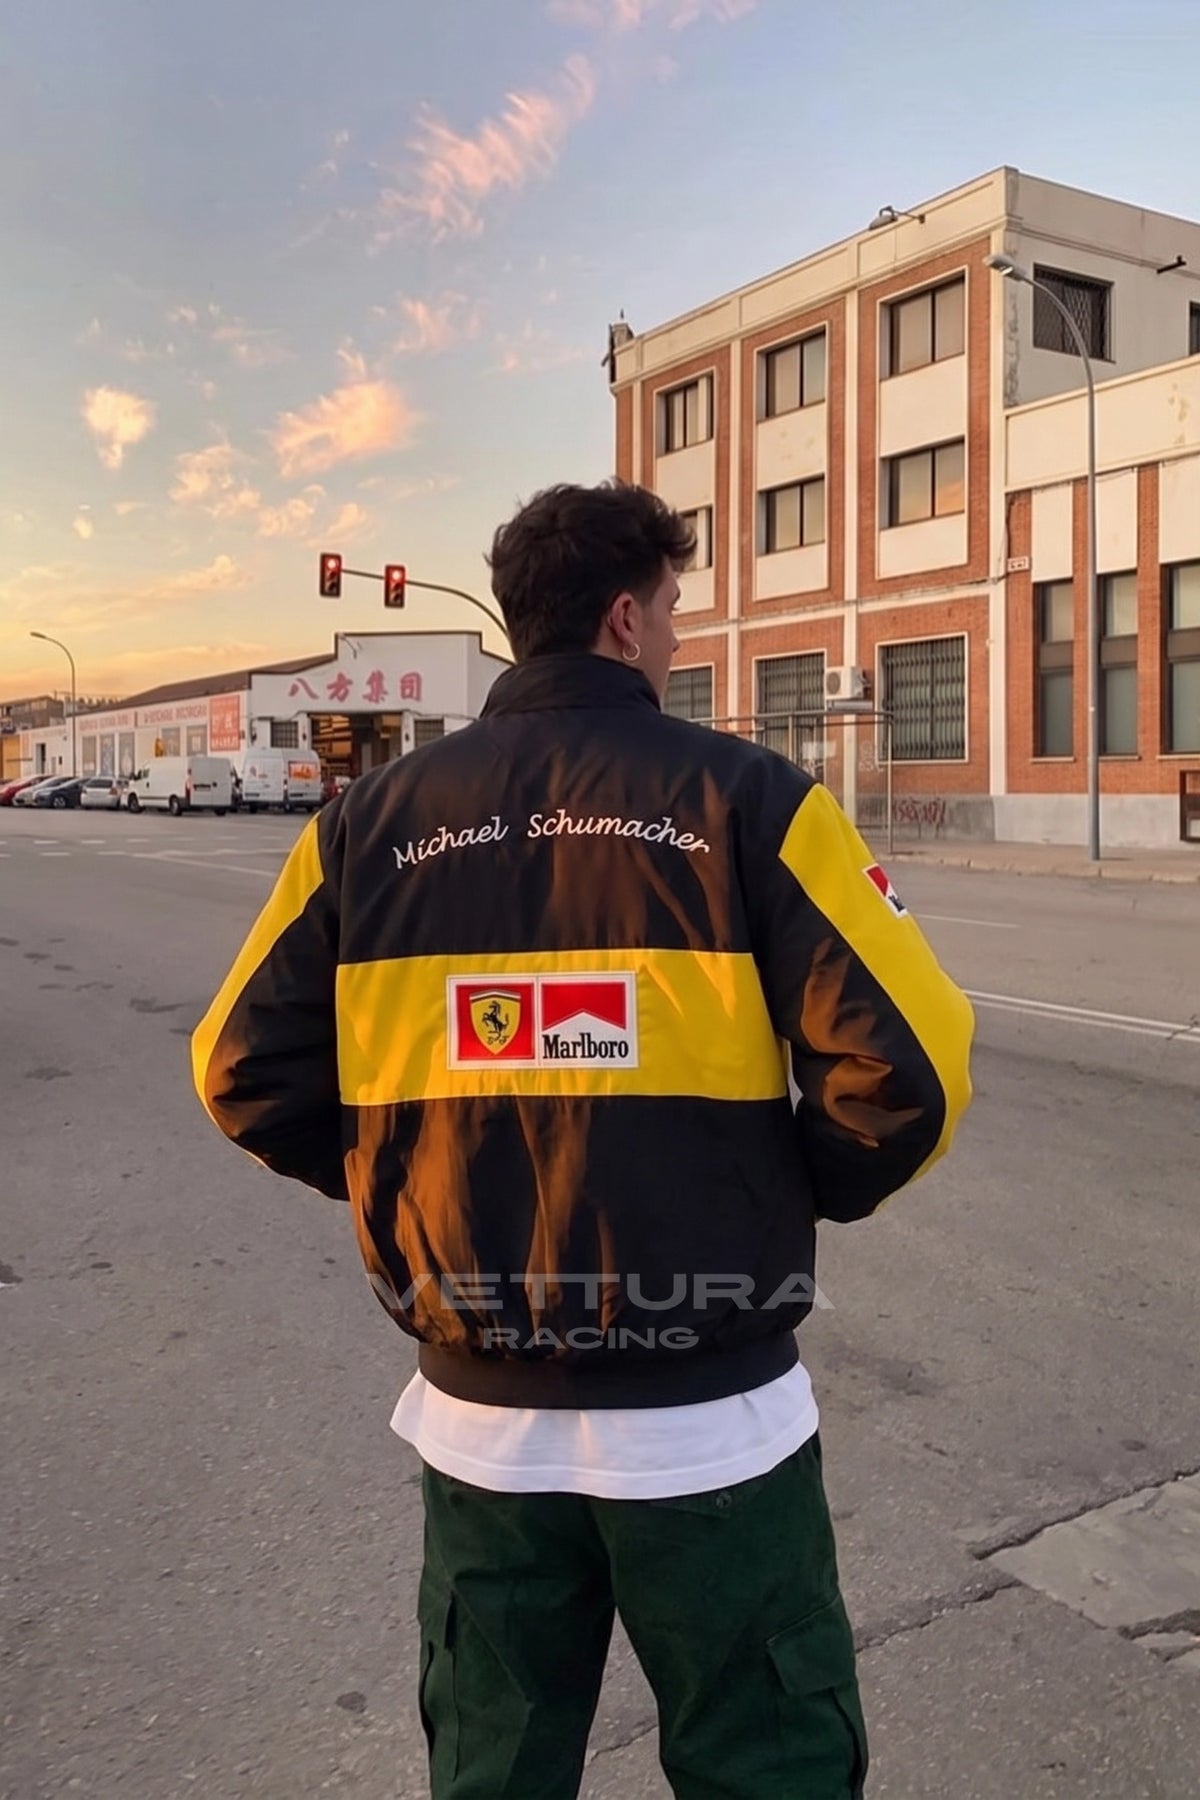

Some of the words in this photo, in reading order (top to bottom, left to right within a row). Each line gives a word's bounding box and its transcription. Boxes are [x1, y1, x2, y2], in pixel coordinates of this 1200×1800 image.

[393, 816, 509, 868] Michael
[526, 809, 710, 853] Schumacher
[542, 1032, 629, 1059] Marlboro
